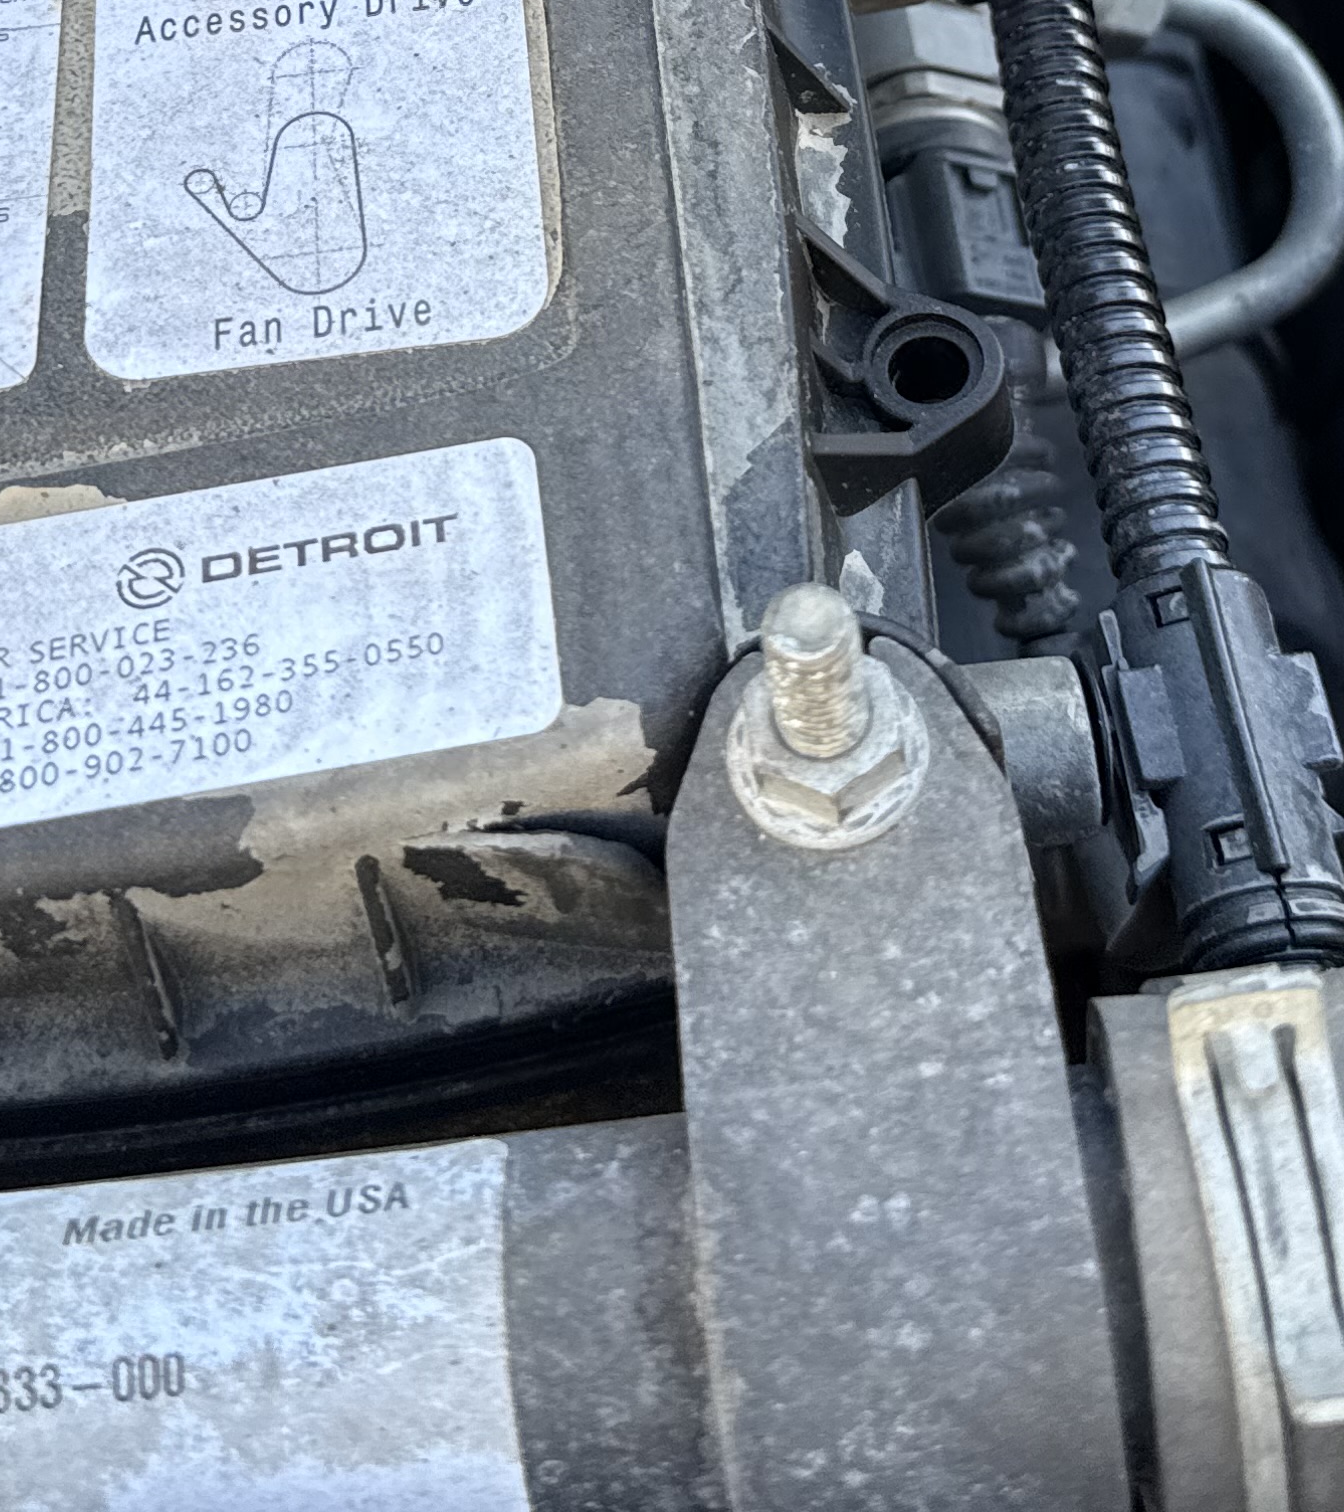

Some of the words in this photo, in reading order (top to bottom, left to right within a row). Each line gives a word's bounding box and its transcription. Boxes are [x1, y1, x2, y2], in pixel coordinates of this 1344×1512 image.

[213, 316, 283, 351] Fan
[312, 297, 434, 339] Drive
[200, 511, 461, 585] DETROIT
[28, 617, 171, 666] SERVICE
[131, 629, 446, 708] 44-162-355-0550
[0, 687, 294, 763] 1-800-445-1980
[61, 1209, 175, 1245] Made
[191, 1204, 228, 1232] in
[245, 1196, 310, 1226] the
[325, 1181, 411, 1218] USA
